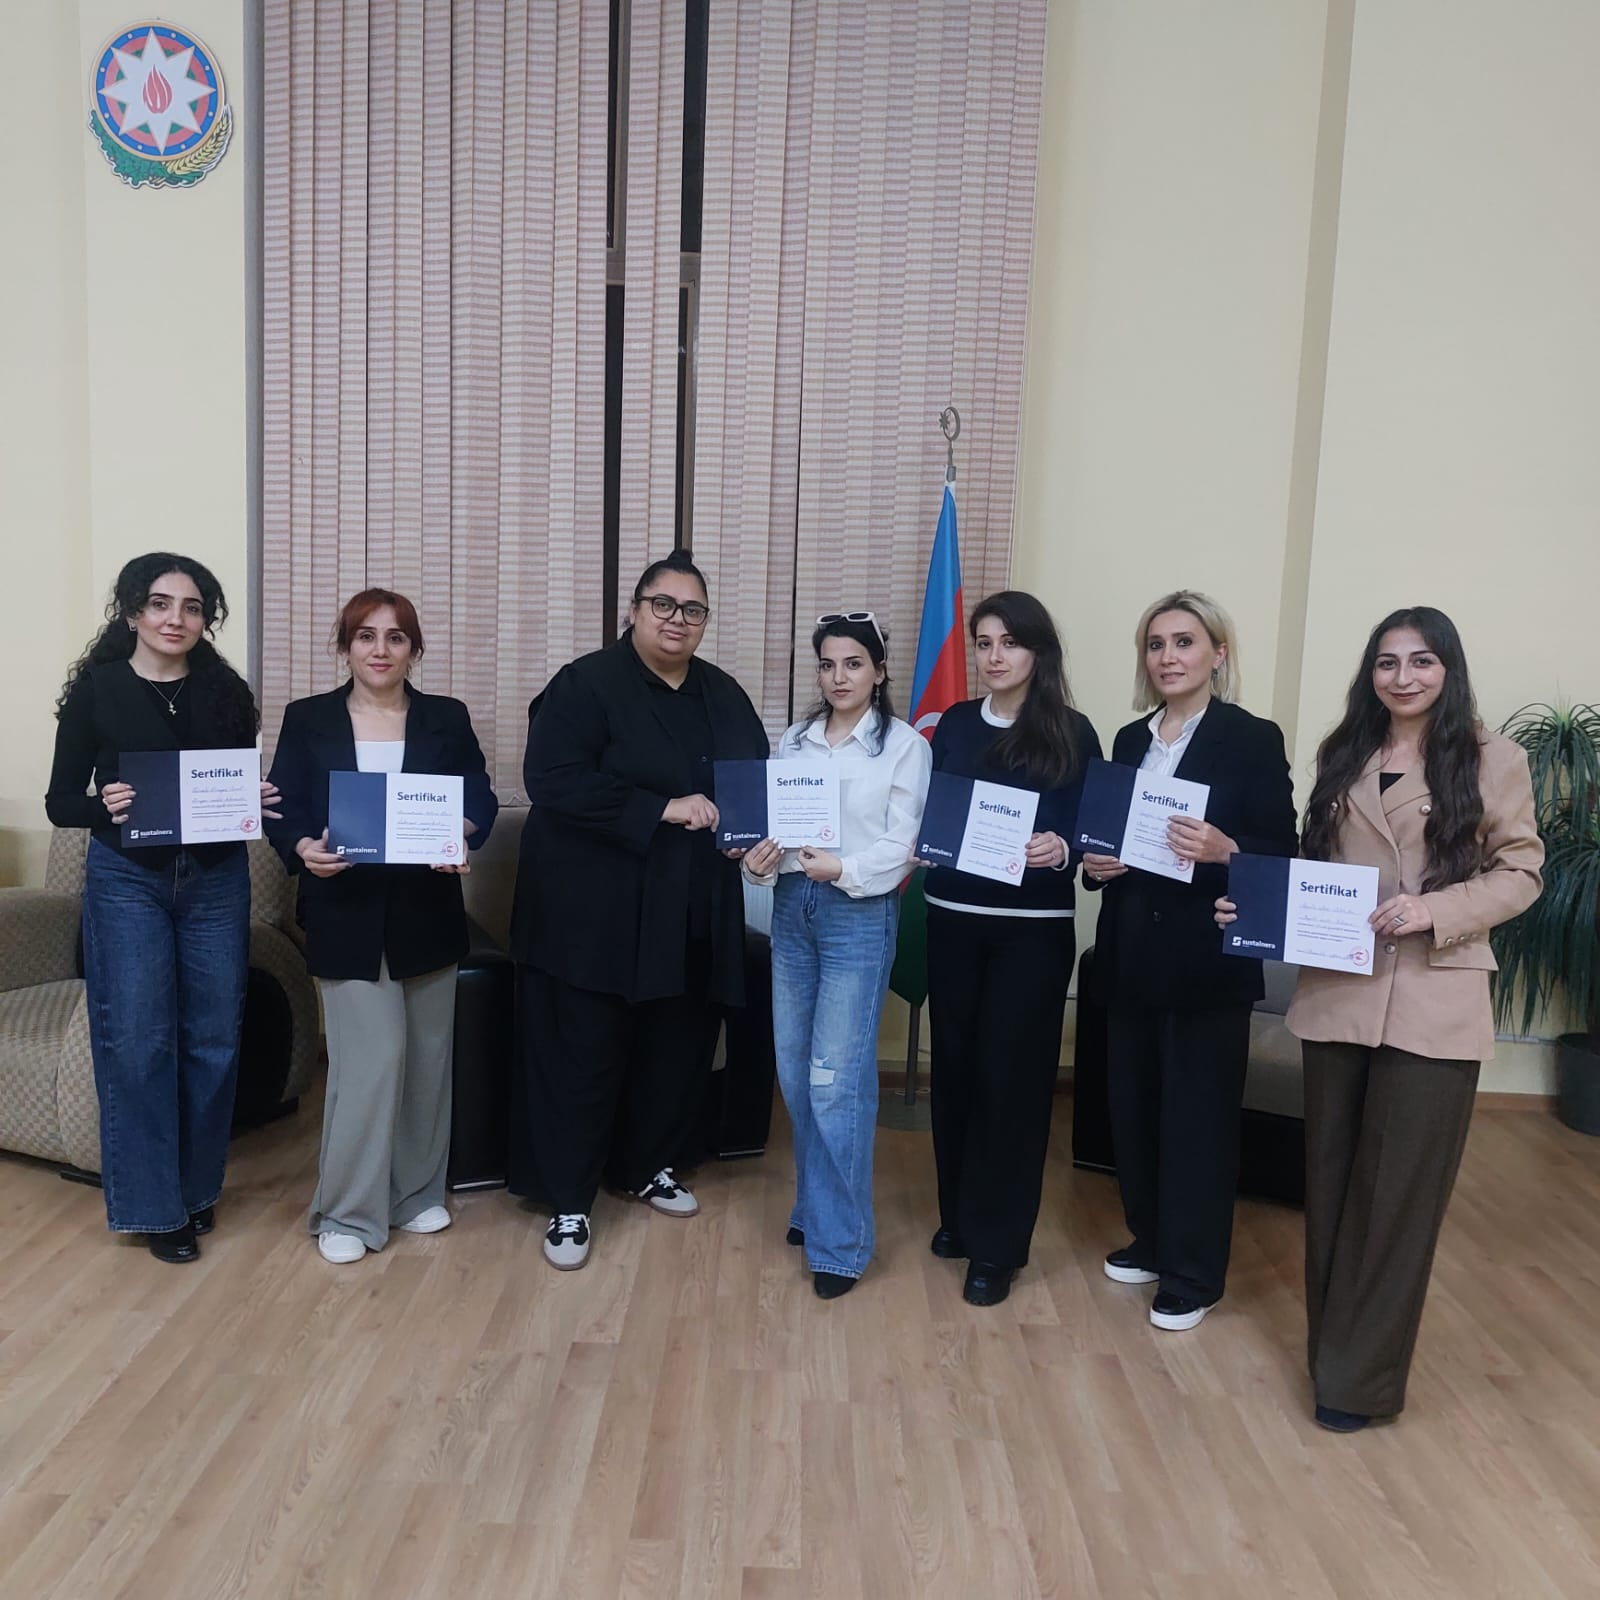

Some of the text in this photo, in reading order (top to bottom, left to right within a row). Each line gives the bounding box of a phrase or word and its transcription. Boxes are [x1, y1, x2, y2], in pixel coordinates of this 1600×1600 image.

[191, 768, 243, 778] Sertifikat
[777, 777, 824, 786] Sertifikat
[397, 791, 447, 803] Sertifikat
[1142, 791, 1189, 811] Sertifikat
[979, 801, 1021, 818] Sertifikat
[346, 846, 377, 854] sustainera
[1300, 881, 1358, 898] Sertifikat
[1242, 939, 1276, 949] sustainera
